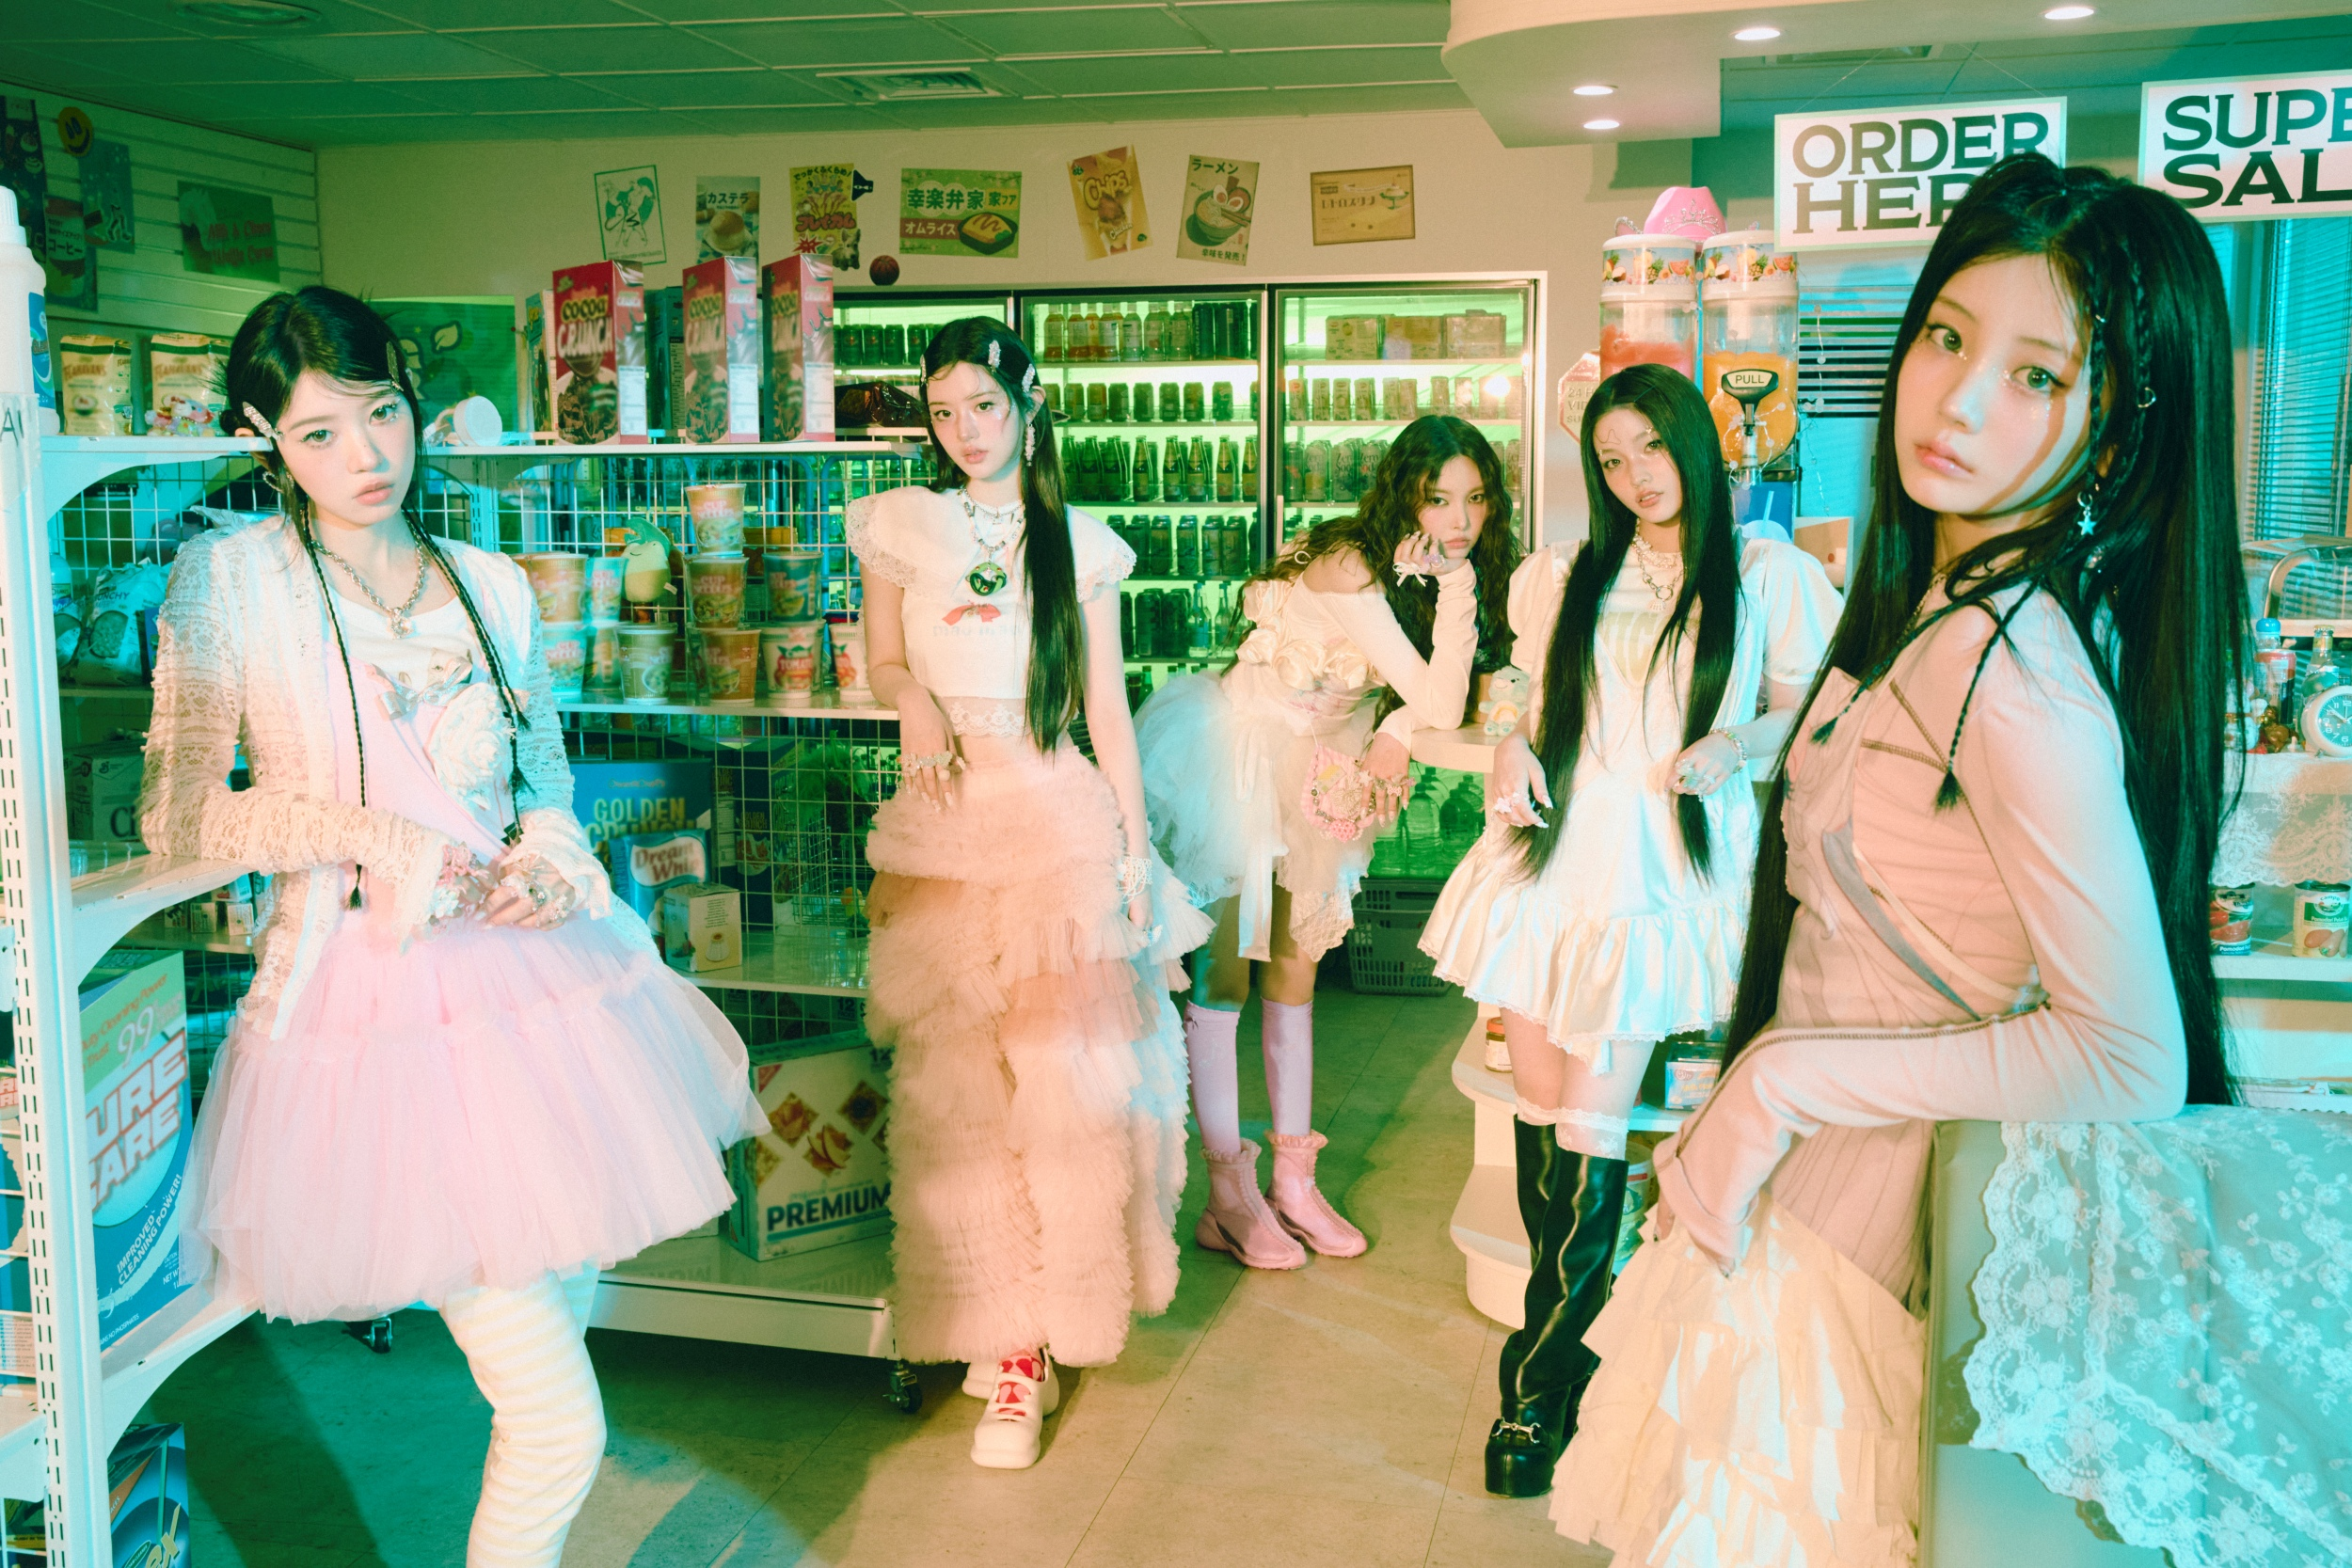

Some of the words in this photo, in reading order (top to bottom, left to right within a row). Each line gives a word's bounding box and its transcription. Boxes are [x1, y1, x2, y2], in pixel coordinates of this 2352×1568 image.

[1792, 112, 2049, 178] ORDER
[1192, 159, 1238, 174] ラーメン
[707, 192, 750, 204] カステラ
[1083, 170, 1129, 210] Chips
[905, 222, 956, 235] オムライス
[558, 316, 613, 358] CRUNCH
[1568, 388, 1581, 398] 24
[1735, 374, 1765, 385] PULL
[594, 798, 685, 822] GOLDEN
[635, 843, 694, 868] Dream
[100, 997, 139, 1036] Cleaning
[139, 973, 168, 1002] Power
[118, 1004, 154, 1069] 99
[86, 1029, 188, 1164] URE
[767, 1181, 891, 1232] PREMIUM
[117, 1213, 155, 1273] IMPROVED
[119, 1227, 158, 1286] CLEANING
[155, 1173, 183, 1227] POWER!
[163, 1272, 174, 1286] NET
[108, 1328, 117, 1340] NO
[115, 1313, 140, 1335] PHOSPHATES
